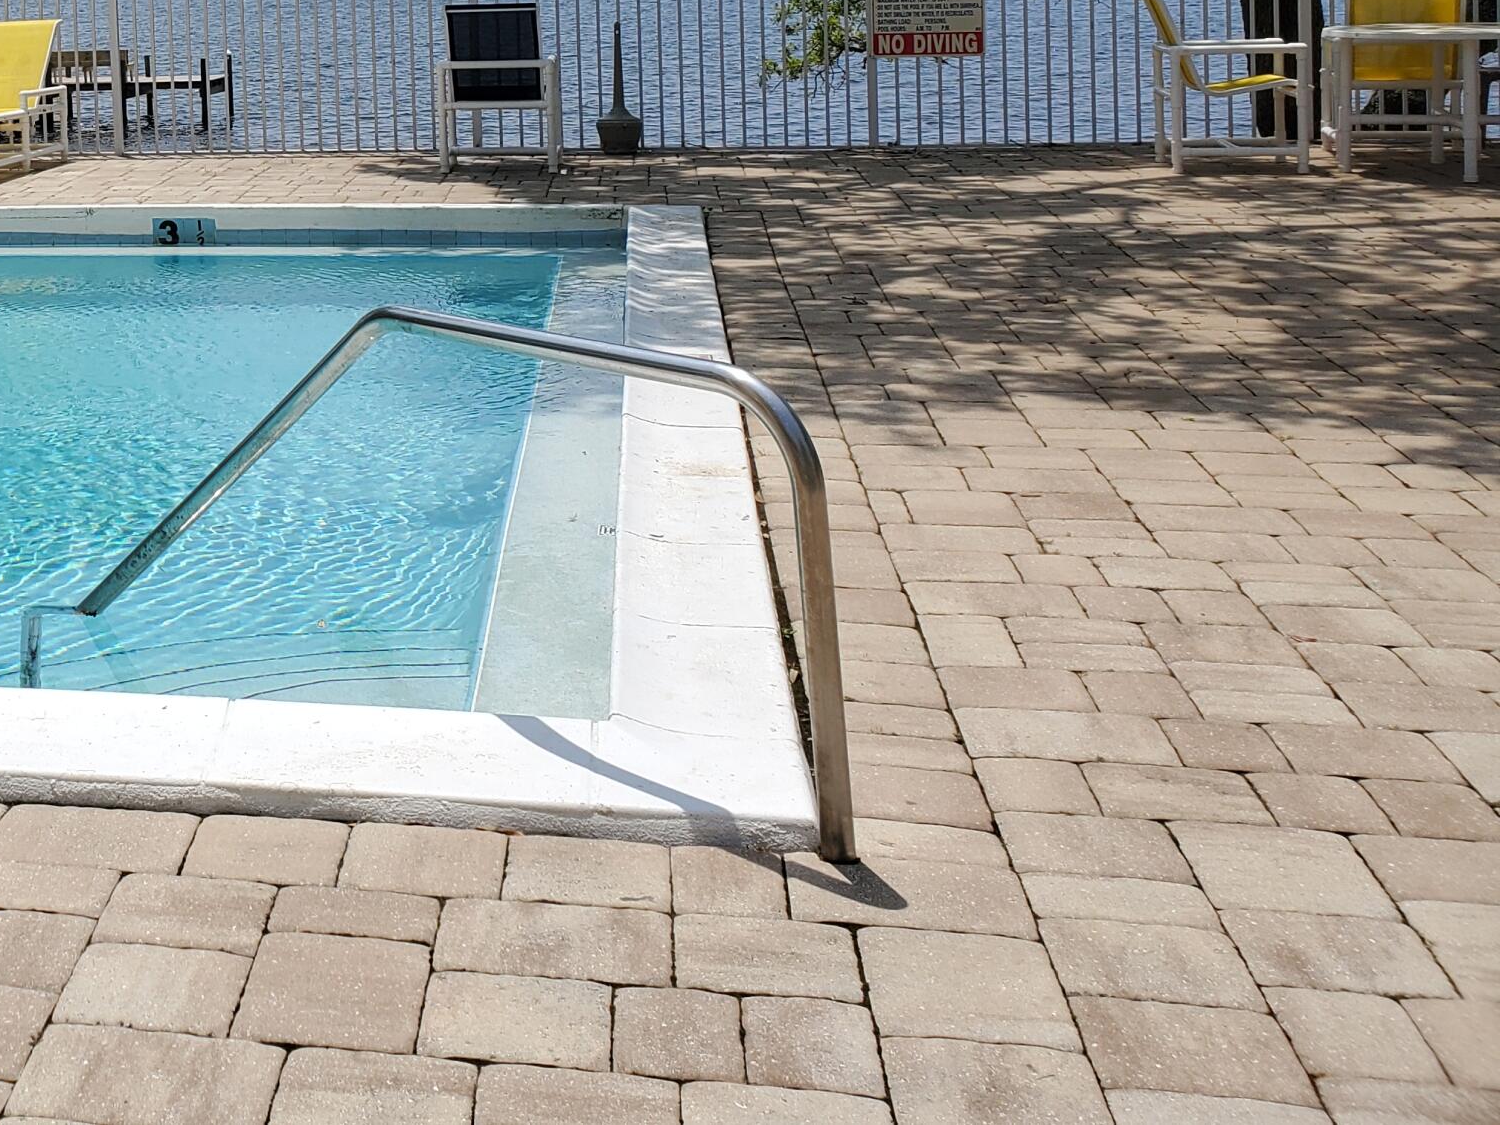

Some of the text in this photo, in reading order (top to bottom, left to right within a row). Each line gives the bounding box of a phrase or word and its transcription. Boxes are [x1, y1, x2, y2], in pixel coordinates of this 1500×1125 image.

[878, 34, 978, 54] NO DIVING
[158, 220, 179, 244] 3
